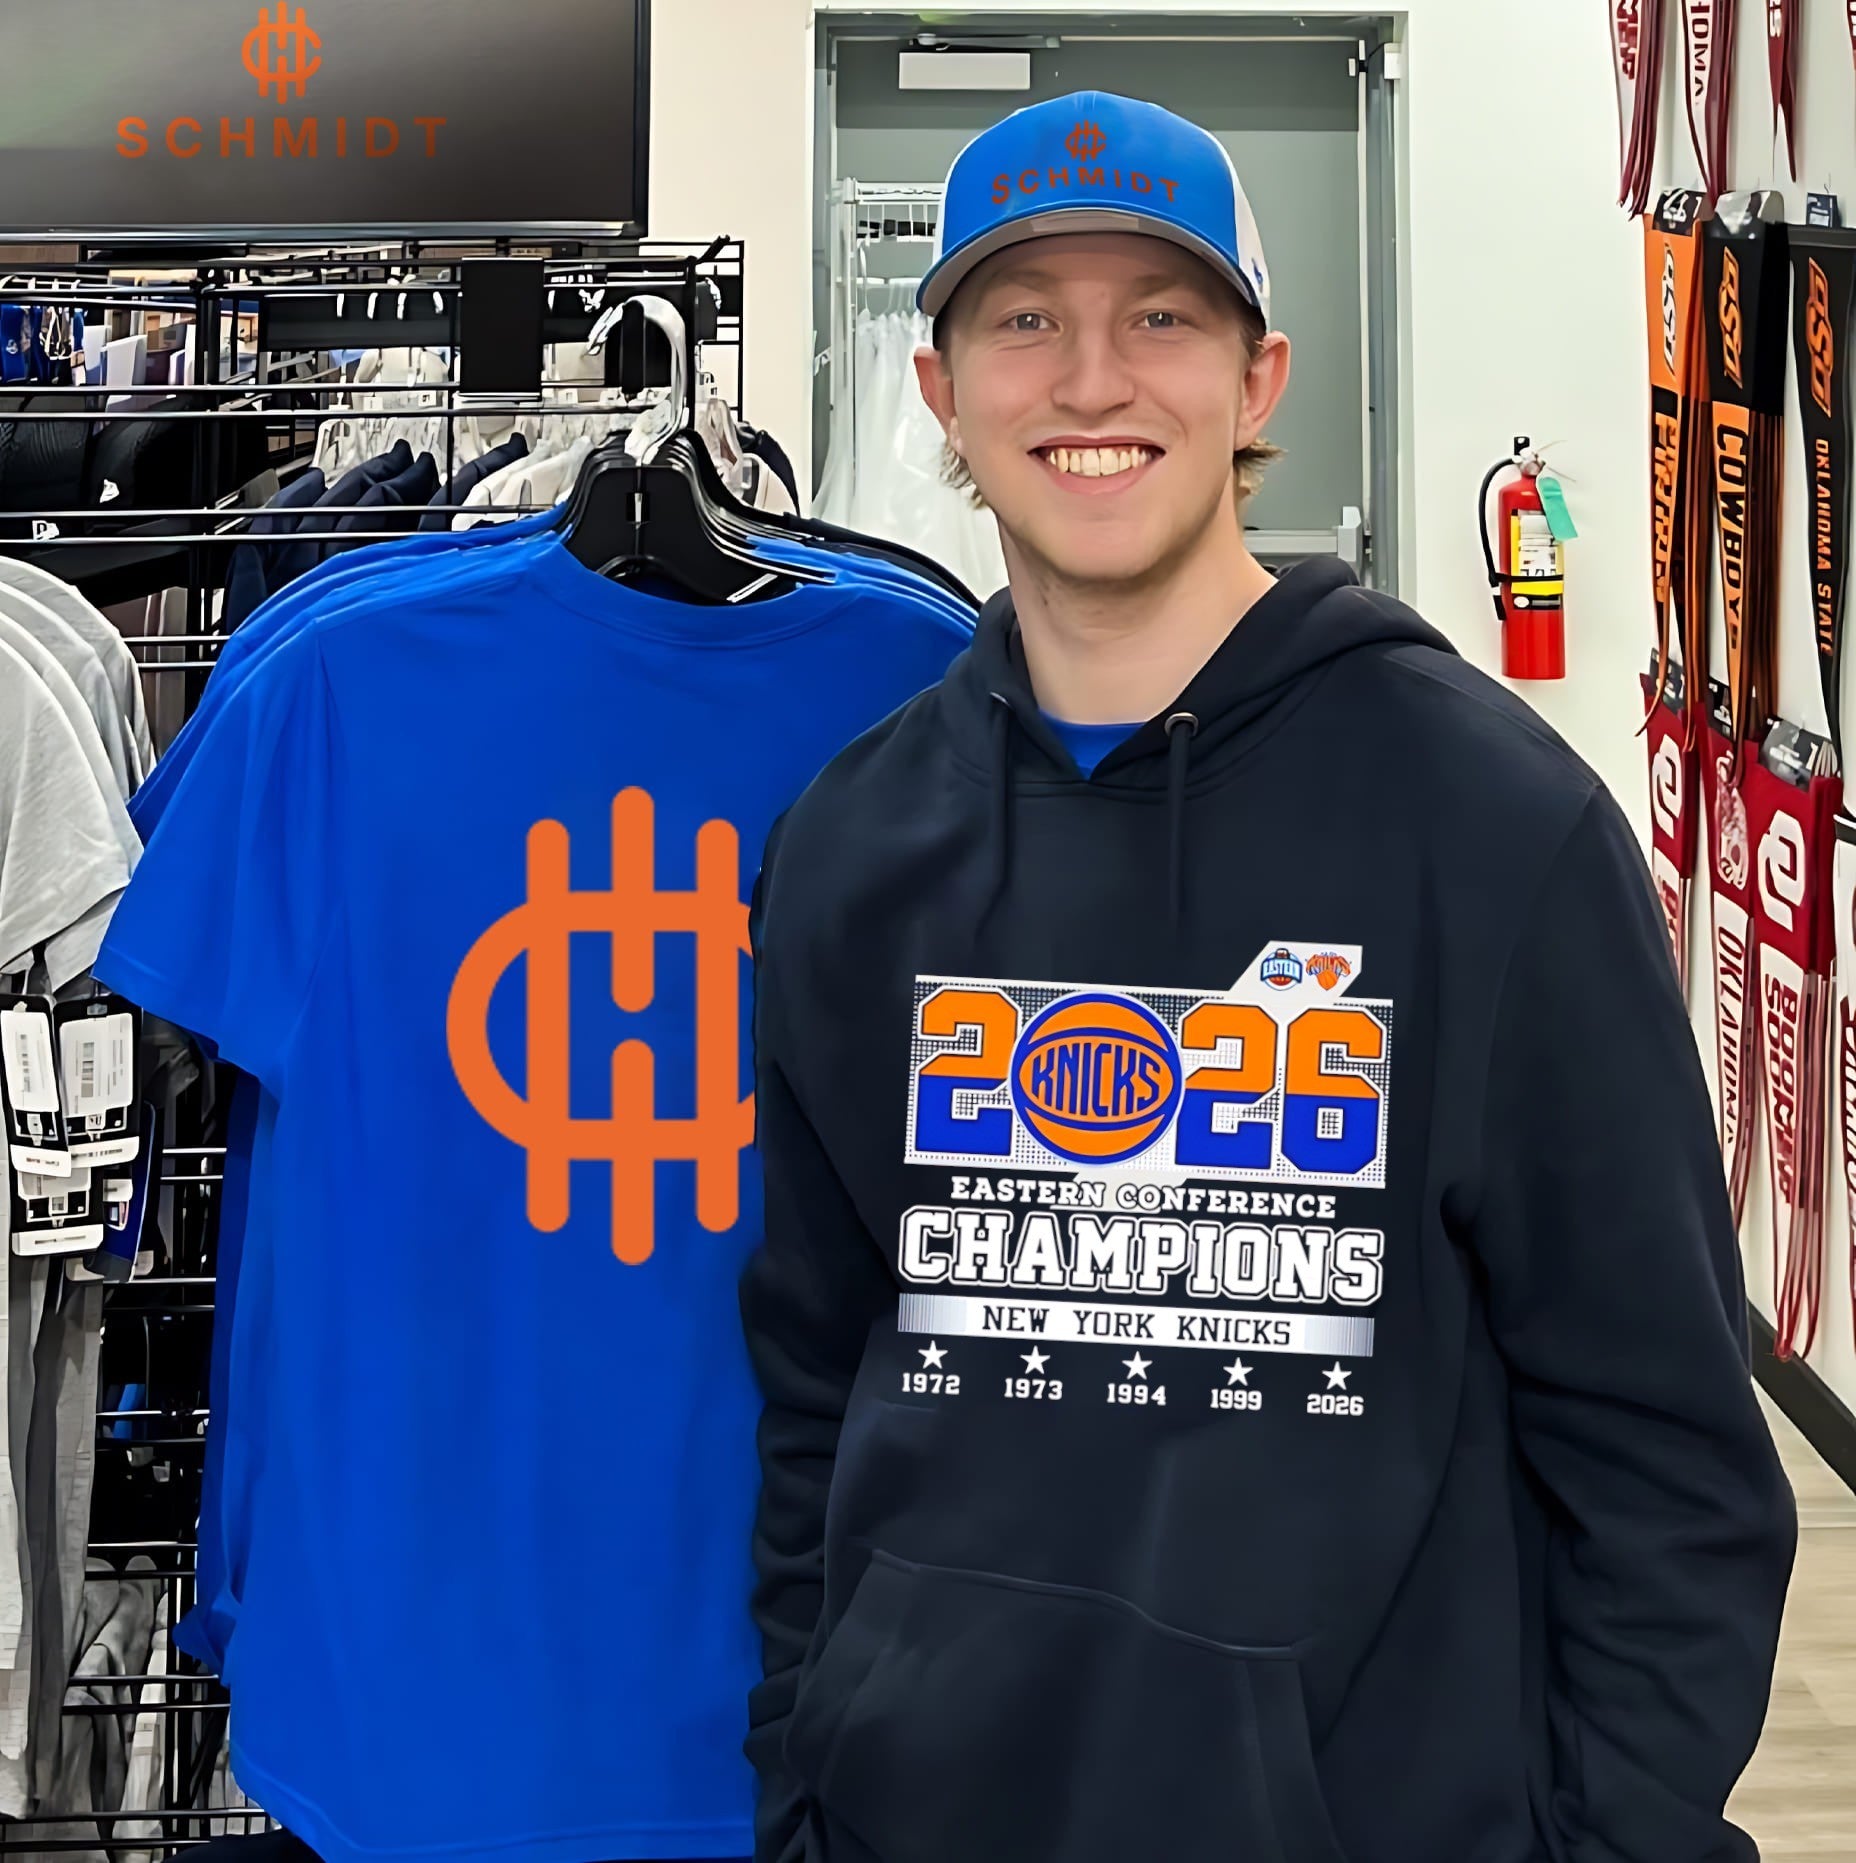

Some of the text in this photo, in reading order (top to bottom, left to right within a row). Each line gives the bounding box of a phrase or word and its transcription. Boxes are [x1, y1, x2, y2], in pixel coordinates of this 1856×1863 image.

[115, 116, 448, 159] SCHMIDT
[991, 167, 1179, 204] SCHMIDT
[1031, 1042, 1161, 1118] KNICKS
[950, 1175, 1337, 1219] EASTERN CONFERENCE
[898, 1205, 1385, 1306] CHAMPIONS
[982, 1305, 1291, 1346] NEW YORK KNICKS
[902, 1372, 1364, 1416] 1972 1973 1994 1999 2026
